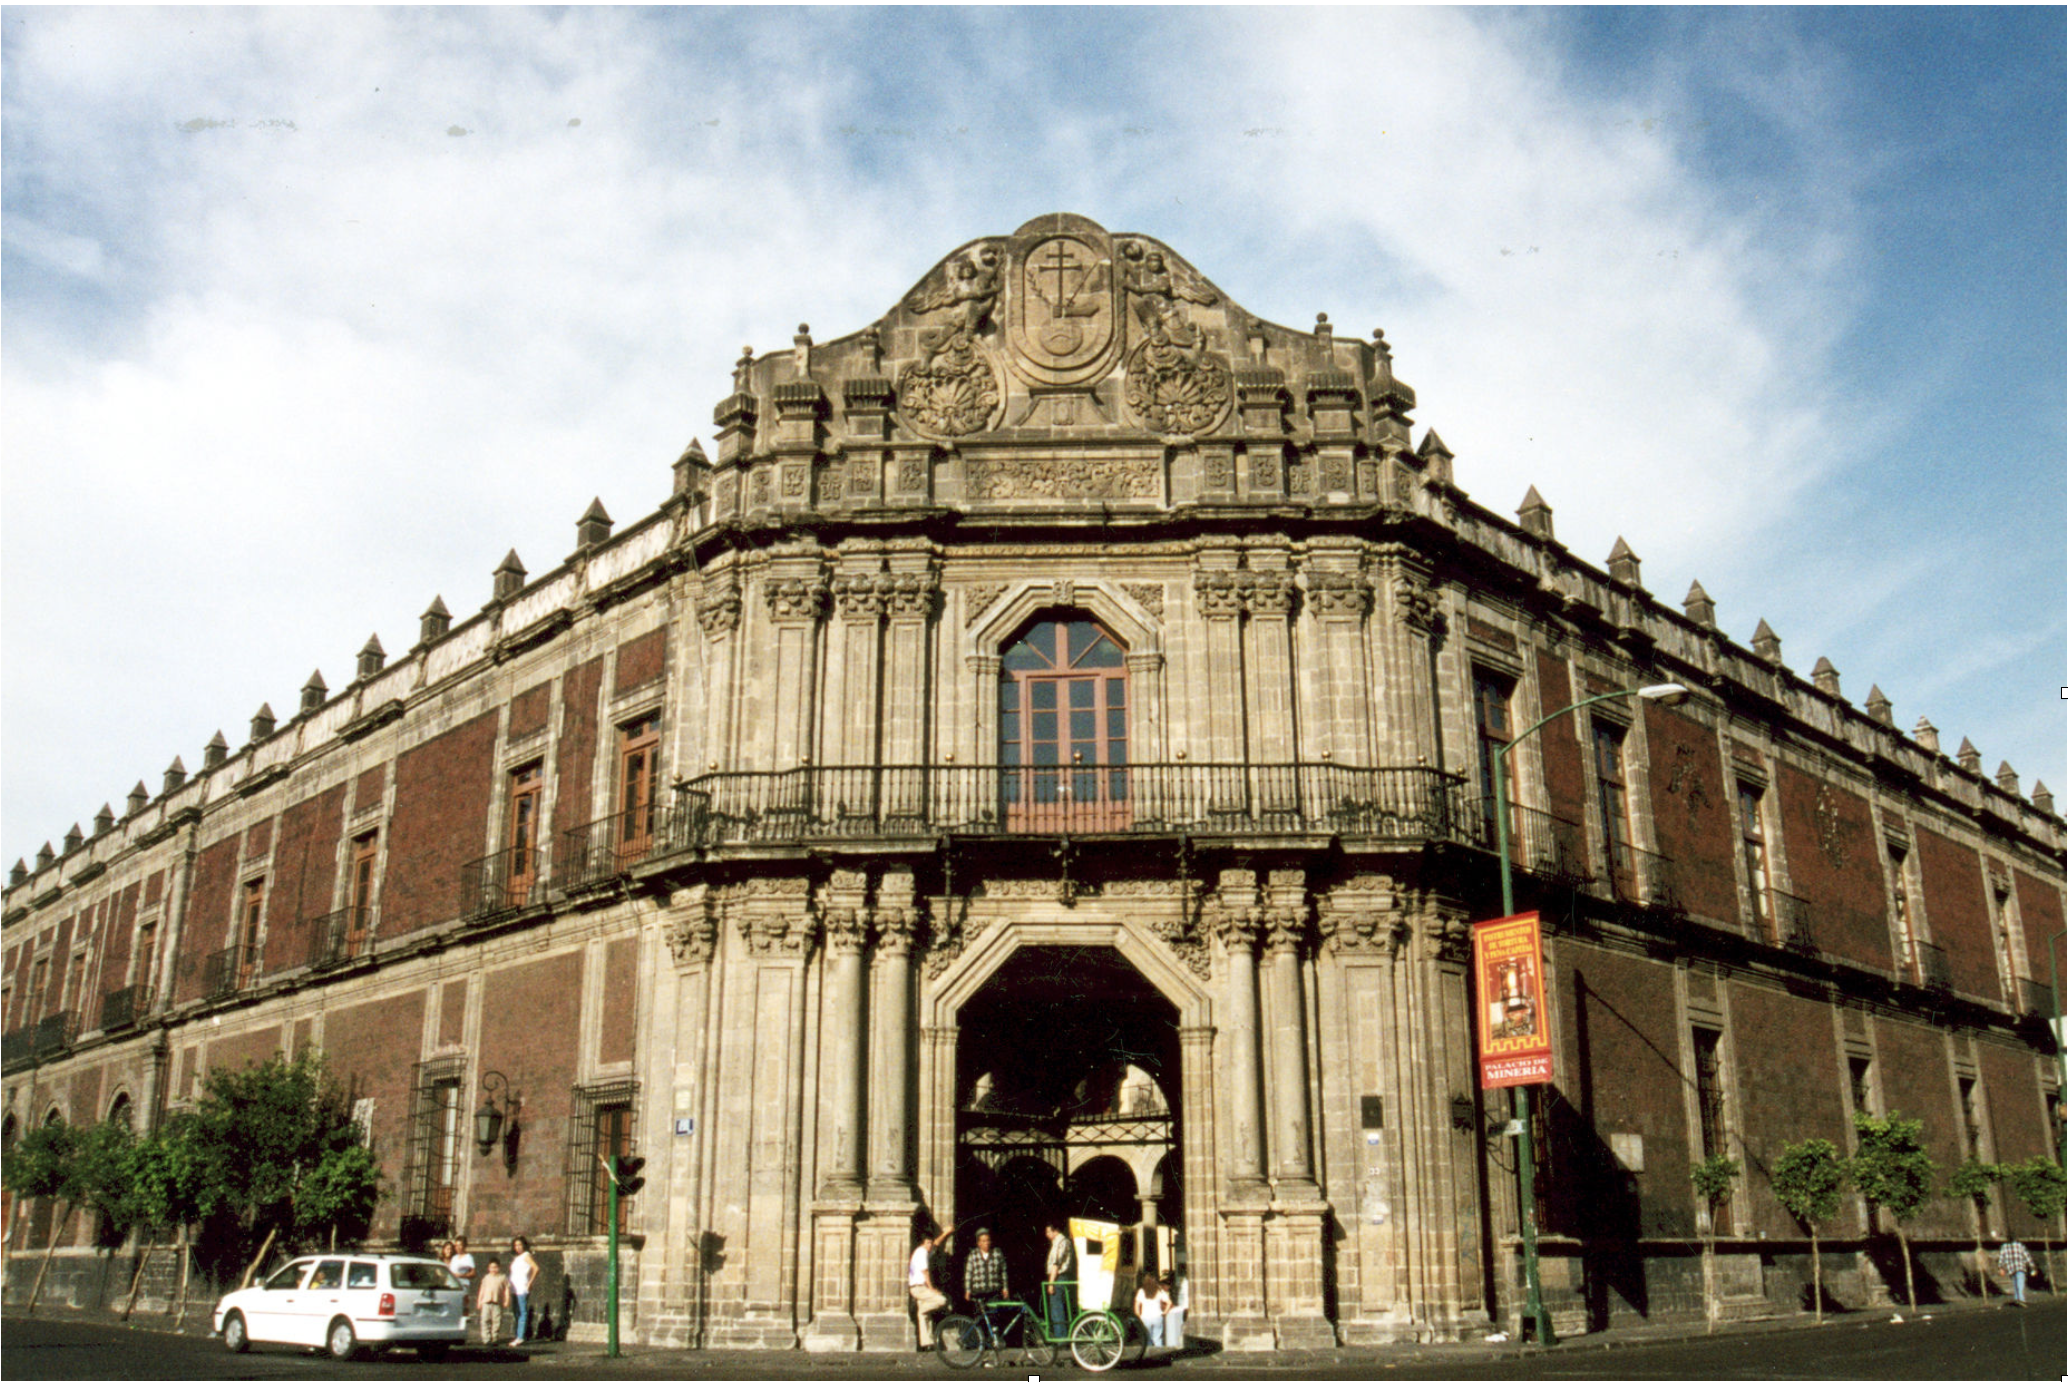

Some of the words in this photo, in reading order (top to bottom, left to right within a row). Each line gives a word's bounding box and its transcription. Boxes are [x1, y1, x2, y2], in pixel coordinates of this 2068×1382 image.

[1485, 1060, 1531, 1071] PALACIO
[1533, 1057, 1549, 1065] DE
[1486, 1065, 1547, 1080] MINERIA
